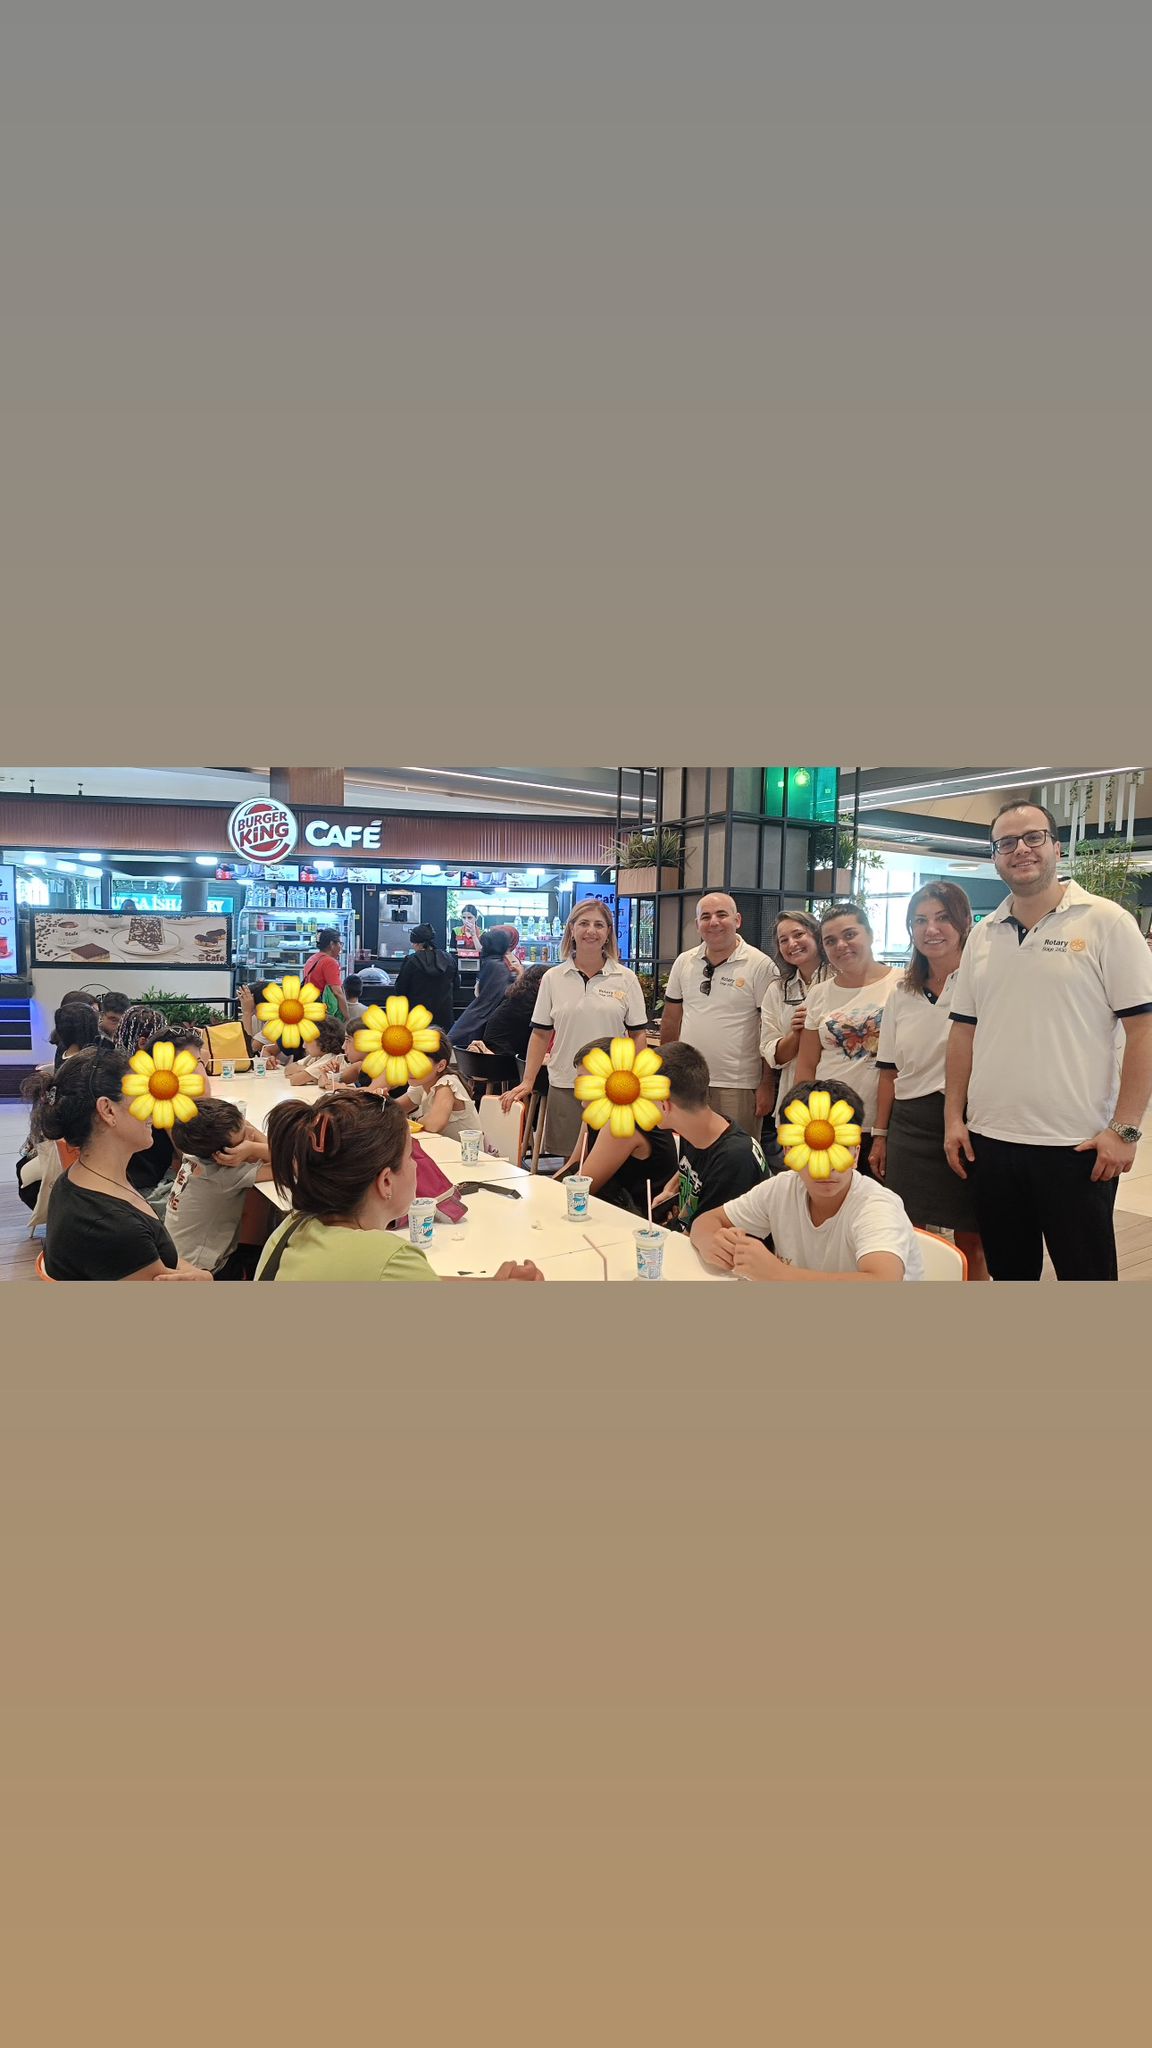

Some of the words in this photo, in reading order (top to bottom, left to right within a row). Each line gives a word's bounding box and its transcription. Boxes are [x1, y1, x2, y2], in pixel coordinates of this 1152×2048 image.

[238, 812, 288, 831] BURGER
[239, 823, 289, 848] KING
[305, 820, 383, 849] CAFÉ
[595, 893, 620, 904] Caf
[1044, 939, 1068, 947] Rotary
[205, 953, 225, 962] Cafe
